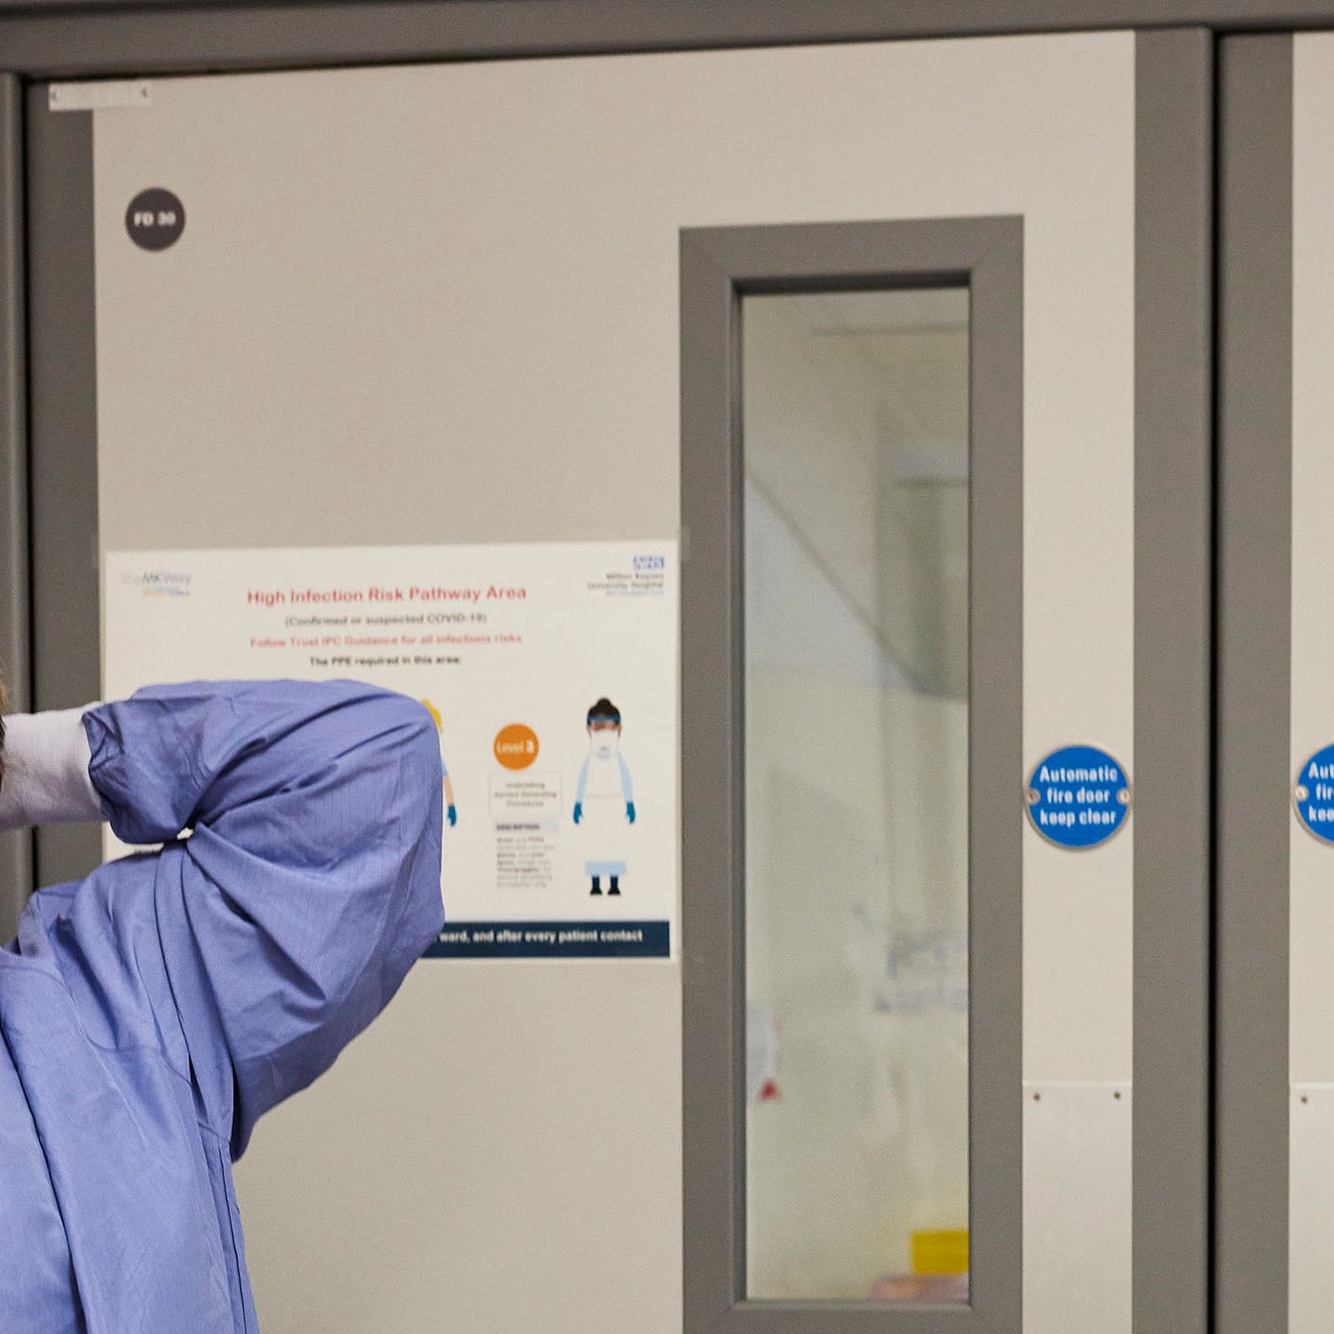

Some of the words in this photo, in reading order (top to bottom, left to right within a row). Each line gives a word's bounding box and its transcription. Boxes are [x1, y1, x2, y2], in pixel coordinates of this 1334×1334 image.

[247, 590, 285, 607] High
[290, 589, 363, 603] Infection
[368, 588, 403, 601] Risk
[409, 586, 480, 603] Pathway
[486, 585, 527, 600] Area
[285, 615, 347, 628] (Confirmed
[350, 617, 361, 625] or
[365, 614, 424, 627] suspected
[427, 613, 487, 625] COVID-19)
[250, 637, 286, 648] Follow
[291, 637, 319, 647] Trust
[321, 636, 341, 647] IPC
[345, 636, 397, 647] Guidance
[401, 635, 416, 645] for
[421, 635, 433, 645] all
[495, 633, 522, 644] risks
[310, 656, 328, 667] The
[331, 656, 352, 667] PPE
[355, 656, 399, 669] required
[402, 656, 411, 666] in
[414, 655, 433, 666] this
[1040, 765, 1117, 782] Automatic
[1047, 787, 1073, 803] fire
[1077, 787, 1109, 803] door
[1040, 808, 1075, 828] keep
[1079, 808, 1115, 825] clear
[439, 930, 471, 944] ward,
[473, 929, 494, 943] and
[496, 929, 522, 943] after
[525, 930, 555, 944] every
[559, 929, 597, 944] patient
[600, 929, 643, 942] contact
